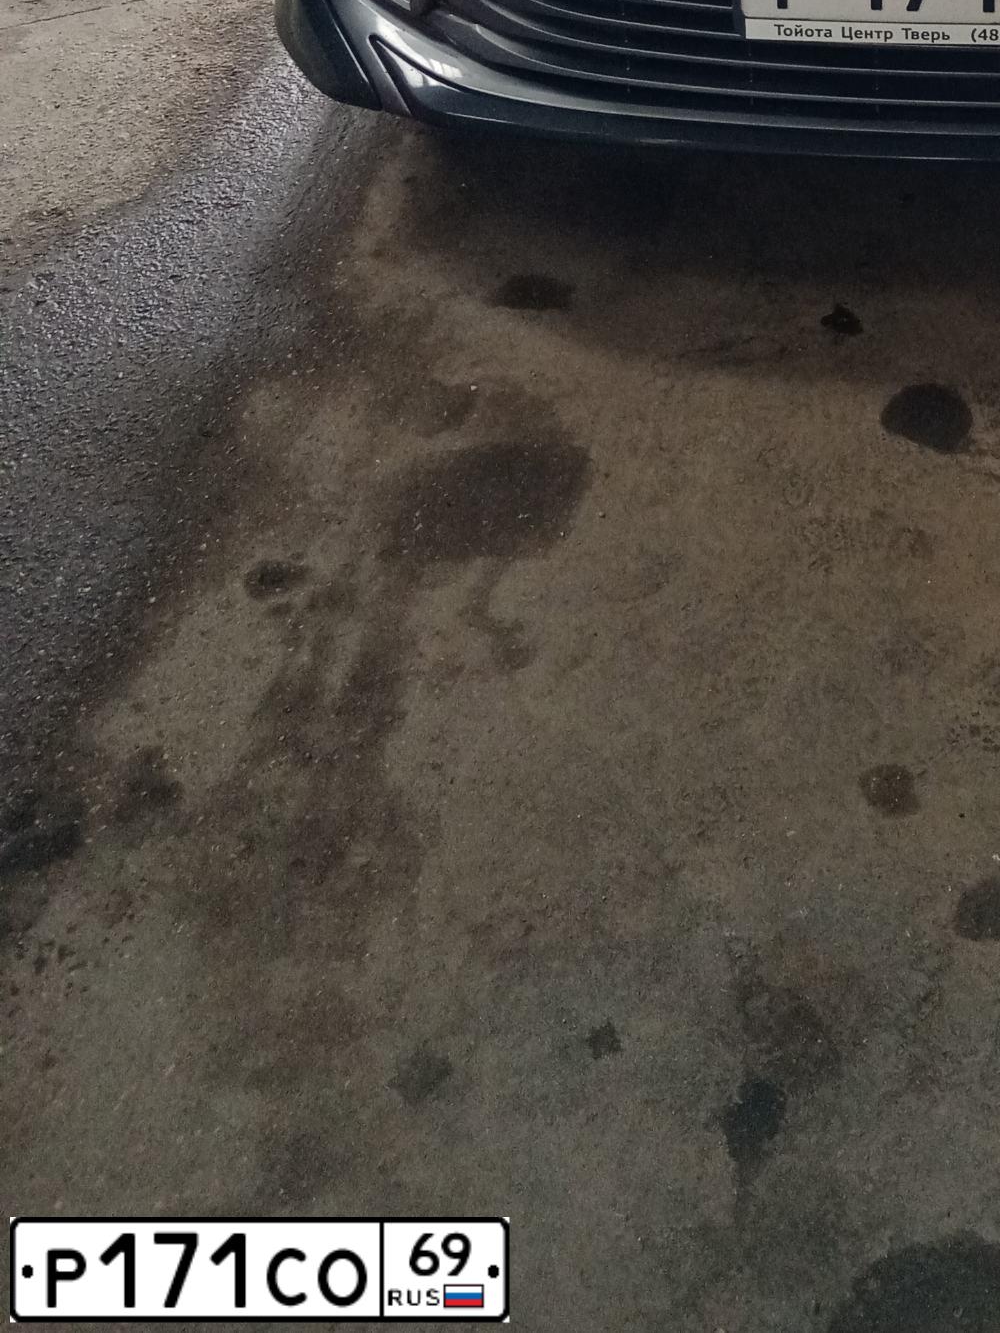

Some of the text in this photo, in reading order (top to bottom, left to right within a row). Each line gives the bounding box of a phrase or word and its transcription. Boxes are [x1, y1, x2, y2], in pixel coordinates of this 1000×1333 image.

[773, 23, 833, 38] Тойота
[841, 26, 894, 43] Центр
[900, 27, 951, 44] Тверь
